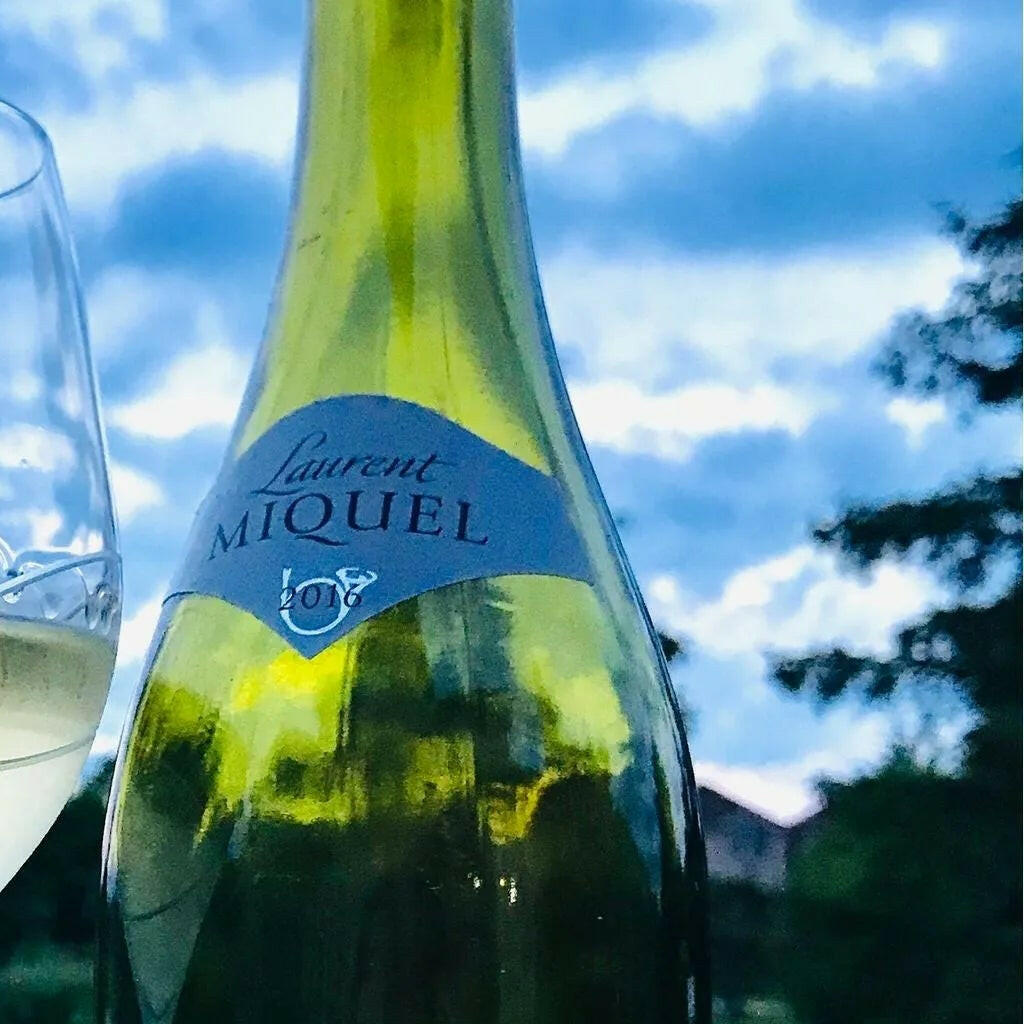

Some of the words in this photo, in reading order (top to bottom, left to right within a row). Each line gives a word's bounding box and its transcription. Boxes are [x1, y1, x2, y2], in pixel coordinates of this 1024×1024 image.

[252, 430, 454, 496] Laurent
[208, 491, 489, 561] MIQUEL
[278, 583, 363, 612] 2016
